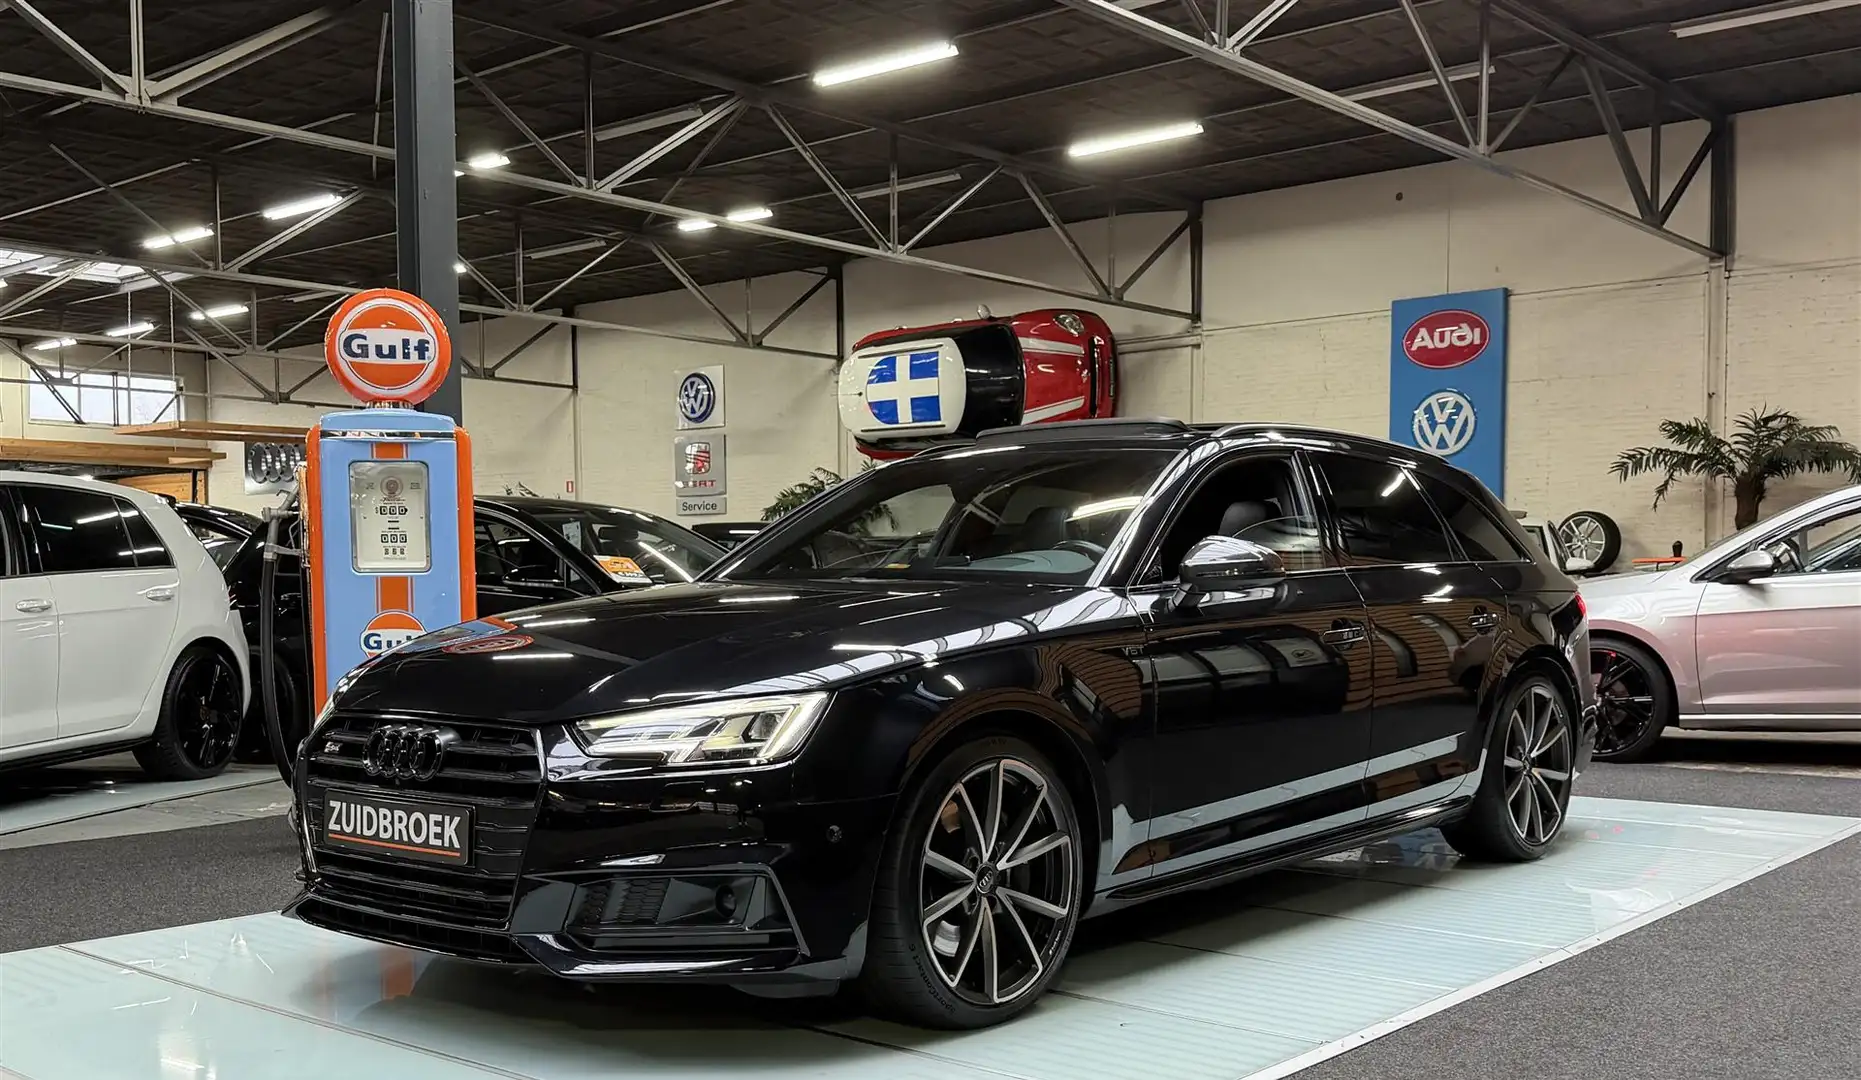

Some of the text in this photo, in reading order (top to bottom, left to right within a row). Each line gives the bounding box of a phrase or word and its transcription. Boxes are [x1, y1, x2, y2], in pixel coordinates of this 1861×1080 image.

[343, 333, 430, 360] Gulf
[682, 500, 717, 511] Service
[328, 800, 461, 848] ZUIDBROEK
